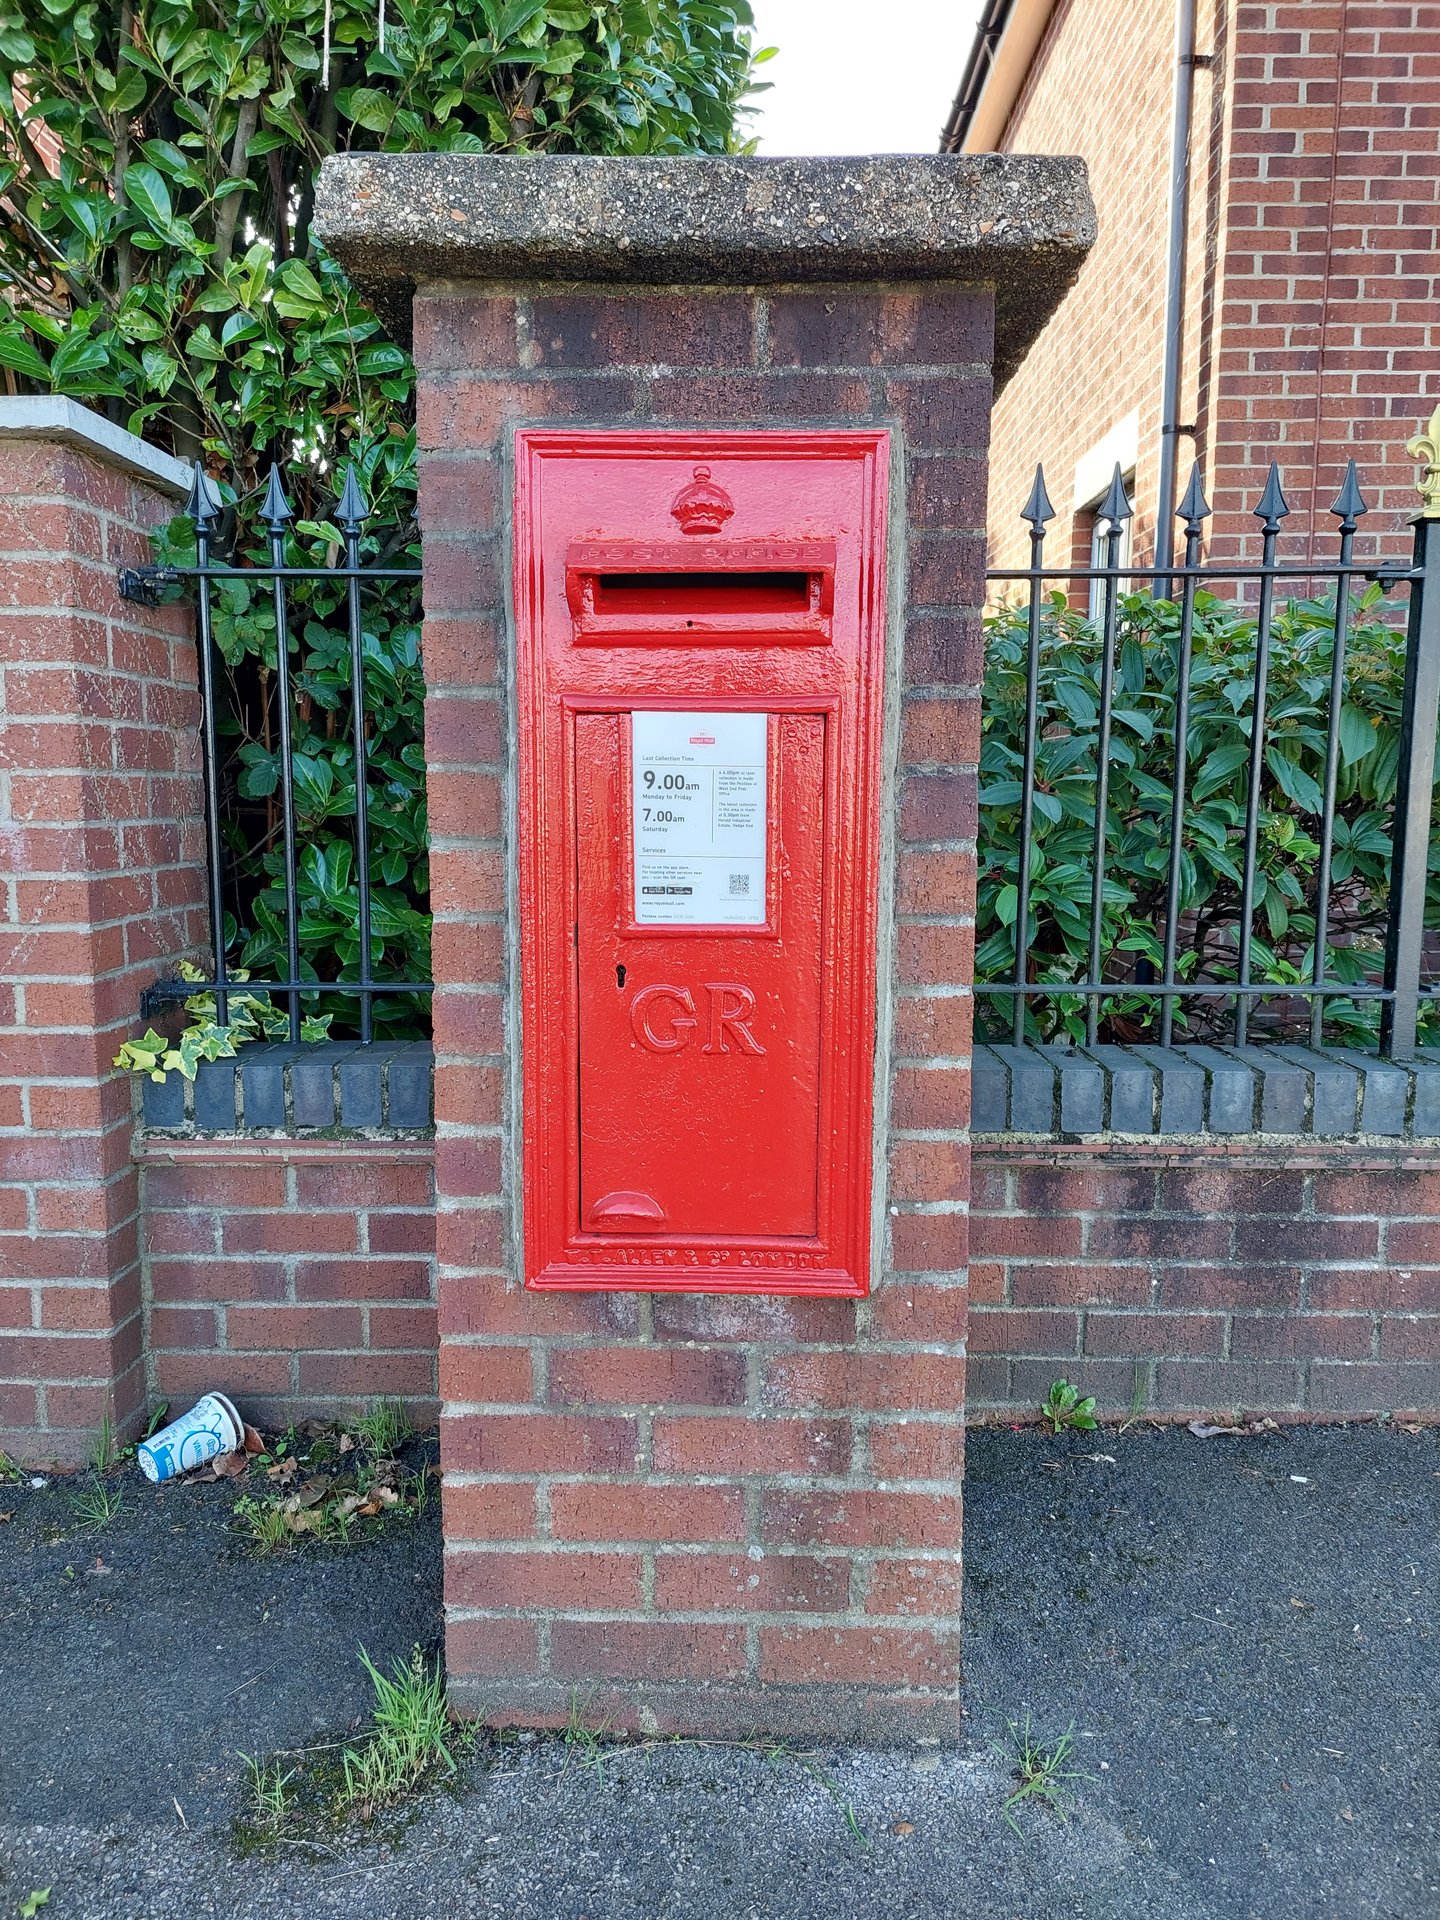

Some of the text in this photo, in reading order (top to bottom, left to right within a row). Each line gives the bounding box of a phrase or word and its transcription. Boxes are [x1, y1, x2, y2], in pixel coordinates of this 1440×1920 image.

[580, 547, 822, 560] POST OFFICE
[643, 770, 700, 790] 9.00am
[642, 808, 685, 822] 7.00am
[630, 983, 766, 1056] GR
[739, 1250, 828, 1269] LONDON
